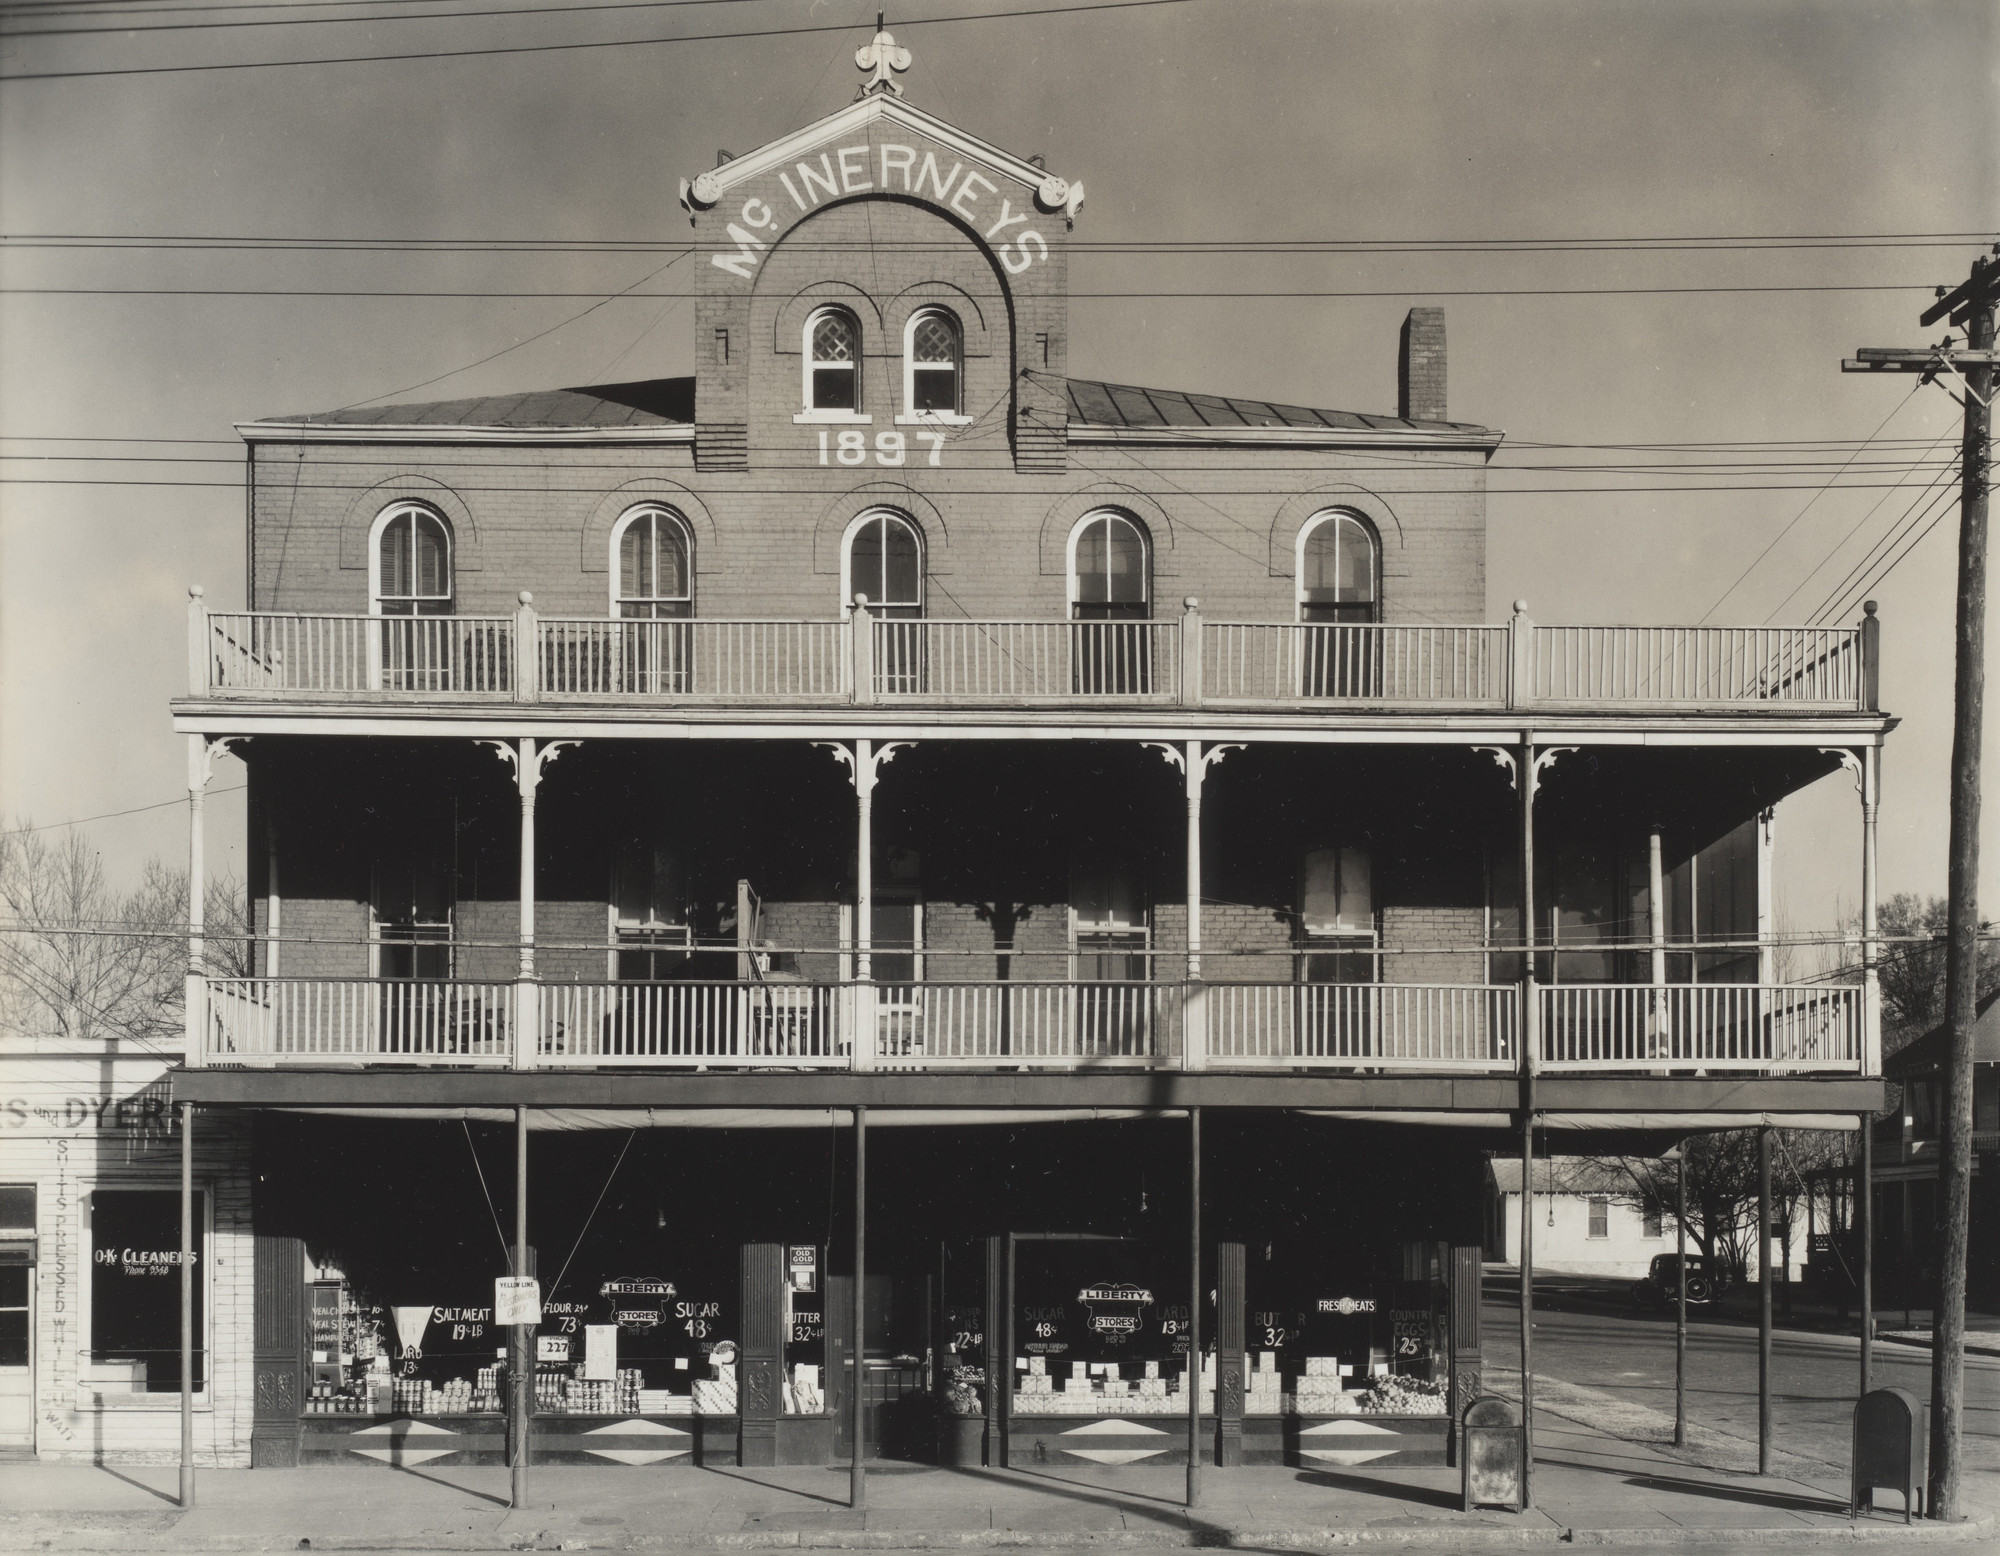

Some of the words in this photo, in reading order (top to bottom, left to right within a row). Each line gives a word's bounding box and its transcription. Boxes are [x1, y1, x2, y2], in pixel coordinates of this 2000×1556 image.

[819, 430, 946, 467] 1897
[0, 1097, 28, 1128] S
[34, 1106, 59, 1128] and
[55, 1139, 69, 1210] SUITS
[55, 1214, 69, 1314] PRESSED
[122, 1248, 197, 1266] CLEANES
[124, 1265, 146, 1275] Phone
[609, 1284, 670, 1293] LIBERTY
[1086, 1291, 1146, 1299] LIBERTY
[543, 1302, 572, 1314] FLOUR
[675, 1302, 720, 1318] SUGAR
[1155, 1305, 1190, 1321] LARD
[1318, 1300, 1347, 1312] FRESH
[1347, 1300, 1375, 1312] MEATS
[433, 1307, 461, 1324] SALT
[461, 1308, 491, 1321] MEAT
[619, 1311, 658, 1320] STORES
[784, 1312, 821, 1323] BUTTER
[1024, 1305, 1065, 1322] SUGAR
[1254, 1311, 1306, 1326] BUTR
[1097, 1317, 1134, 1326] STORES
[472, 1325, 484, 1338] LB
[1394, 1322, 1426, 1337] EGGS
[314, 1333, 354, 1342] HAMBUGER
[974, 1333, 983, 1345] LB
[394, 1346, 423, 1360] LARD
[45, 1411, 77, 1442] WAIT
